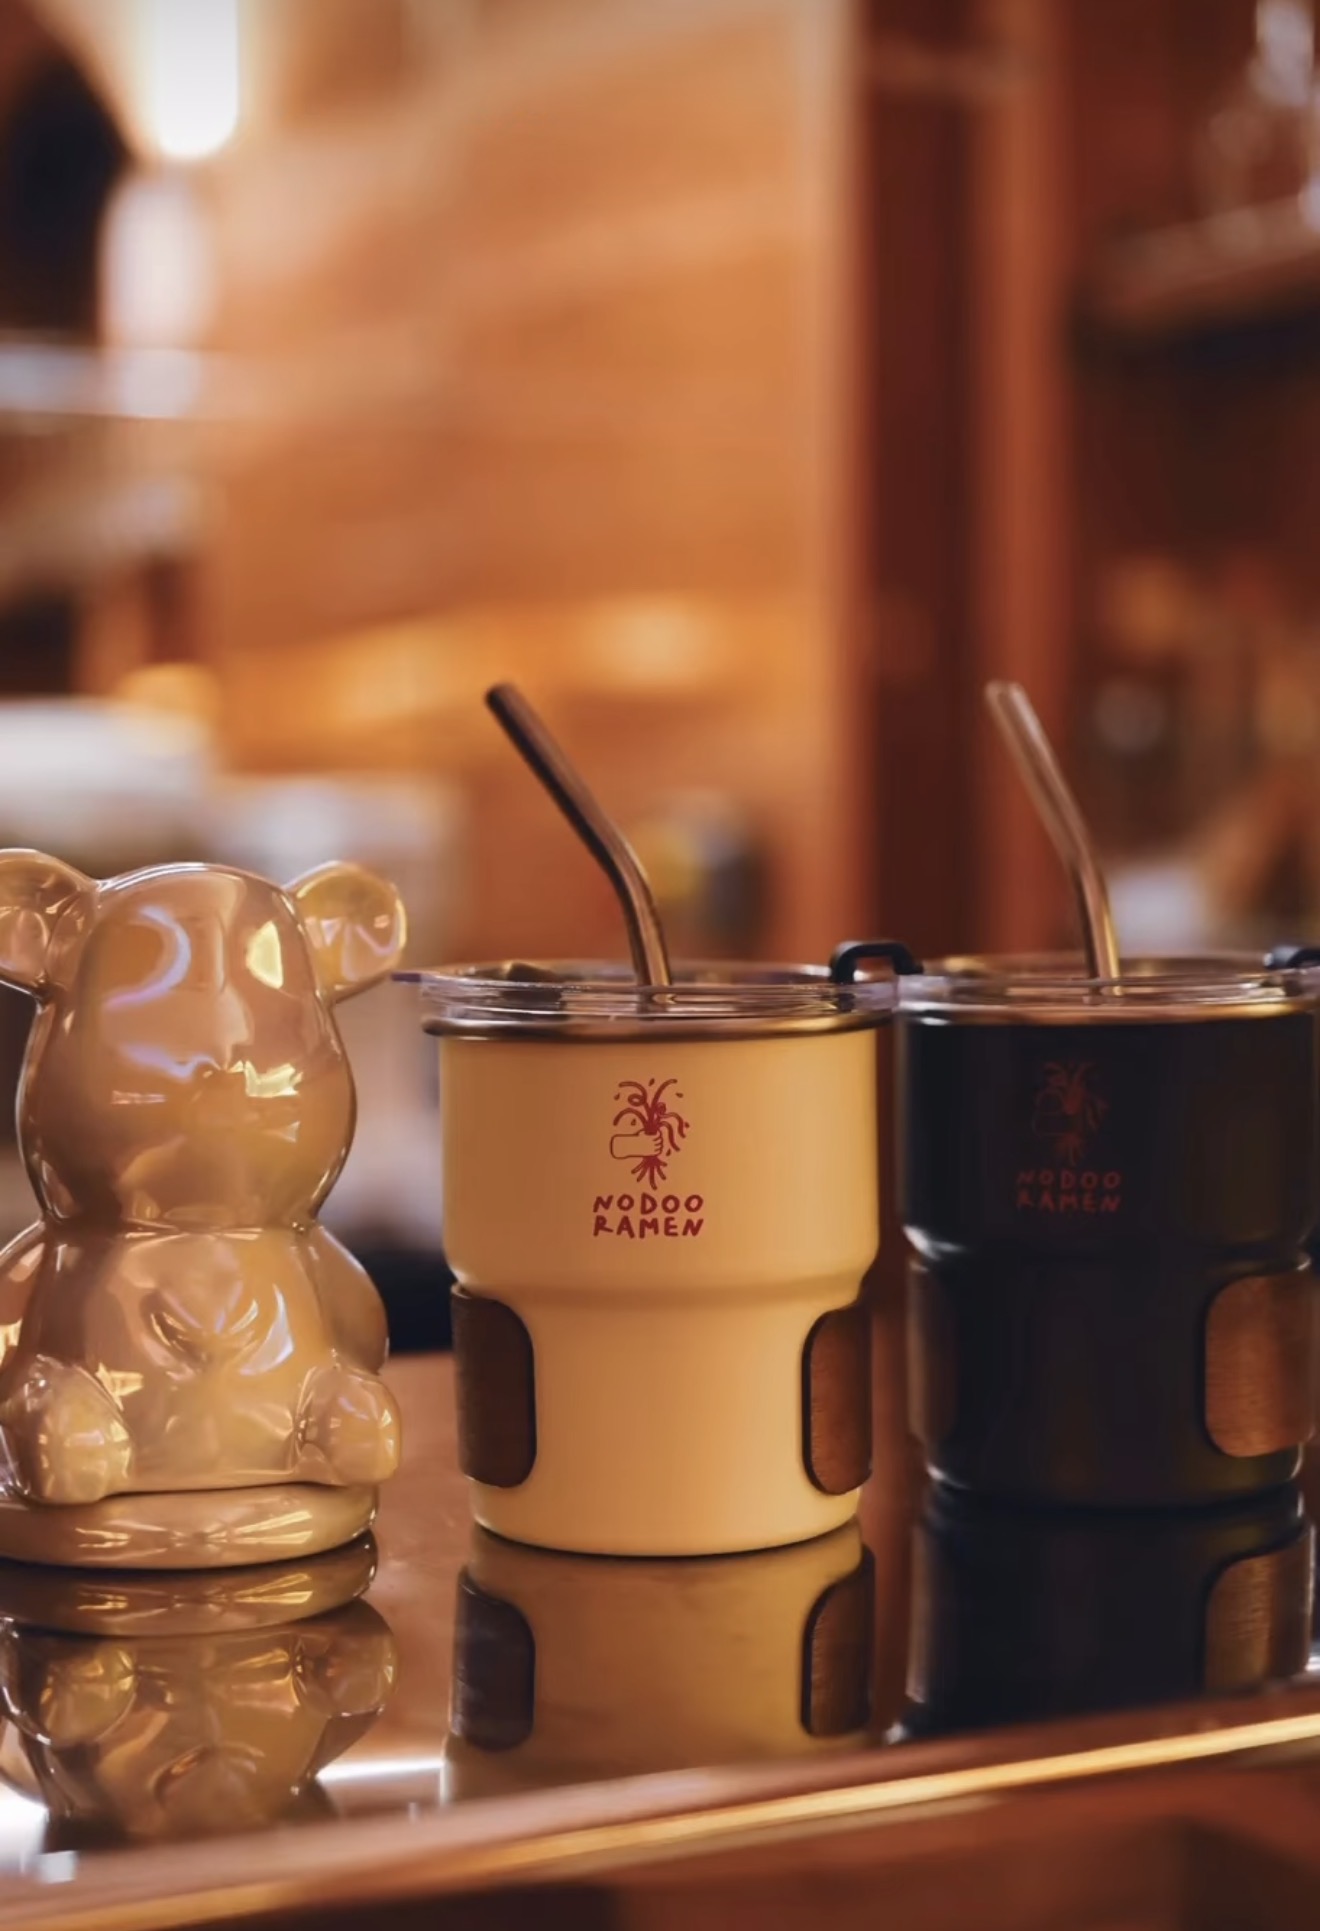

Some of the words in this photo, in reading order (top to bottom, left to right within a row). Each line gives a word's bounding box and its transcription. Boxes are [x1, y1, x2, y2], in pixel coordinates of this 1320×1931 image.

[1016, 1169, 1121, 1190] NODOO
[593, 1193, 704, 1215] NODOO
[1017, 1190, 1121, 1213] RAMEN
[593, 1215, 704, 1239] RAMEN
